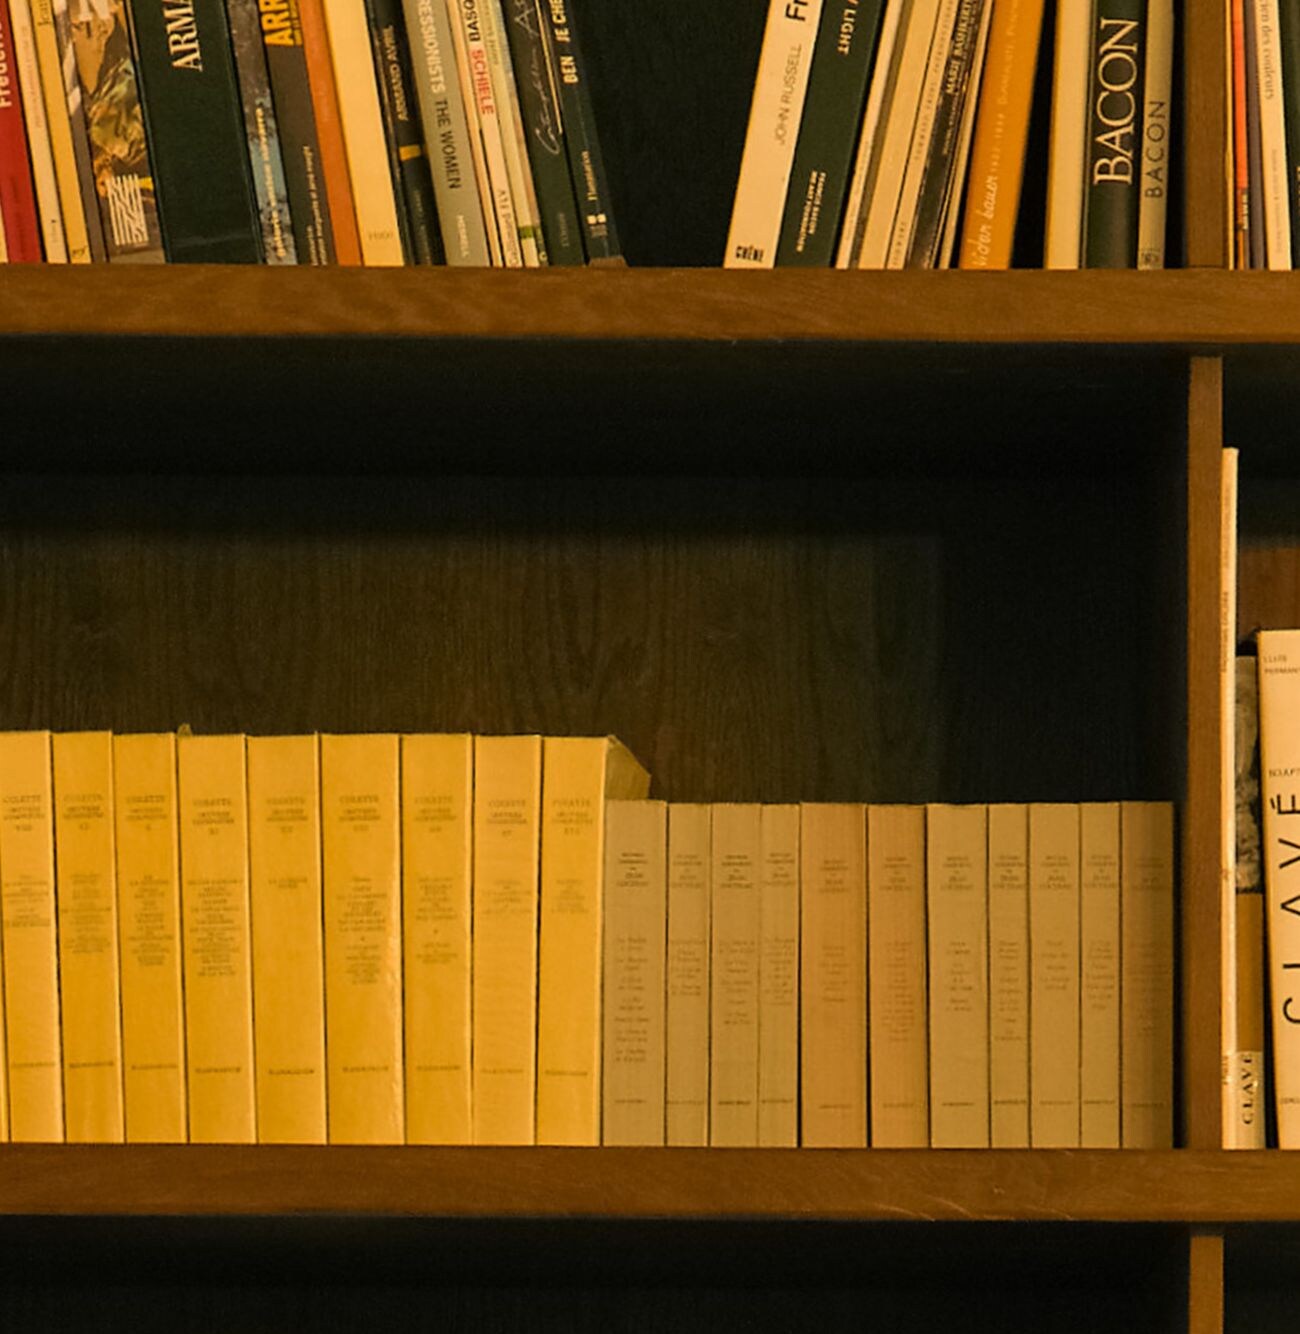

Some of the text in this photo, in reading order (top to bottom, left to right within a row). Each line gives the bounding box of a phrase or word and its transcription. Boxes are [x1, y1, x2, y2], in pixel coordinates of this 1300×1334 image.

[837, 9, 857, 56] LIGHT
[470, 50, 495, 115] SCHIELE
[560, 55, 579, 85] BEN
[774, 44, 803, 145] JOHN RUSSELL
[435, 99, 452, 131] THE
[1093, 17, 1140, 186] BACON
[439, 129, 462, 190] WOMEN
[580, 151, 598, 201] Flammarion
[1144, 99, 1167, 199] BACON
